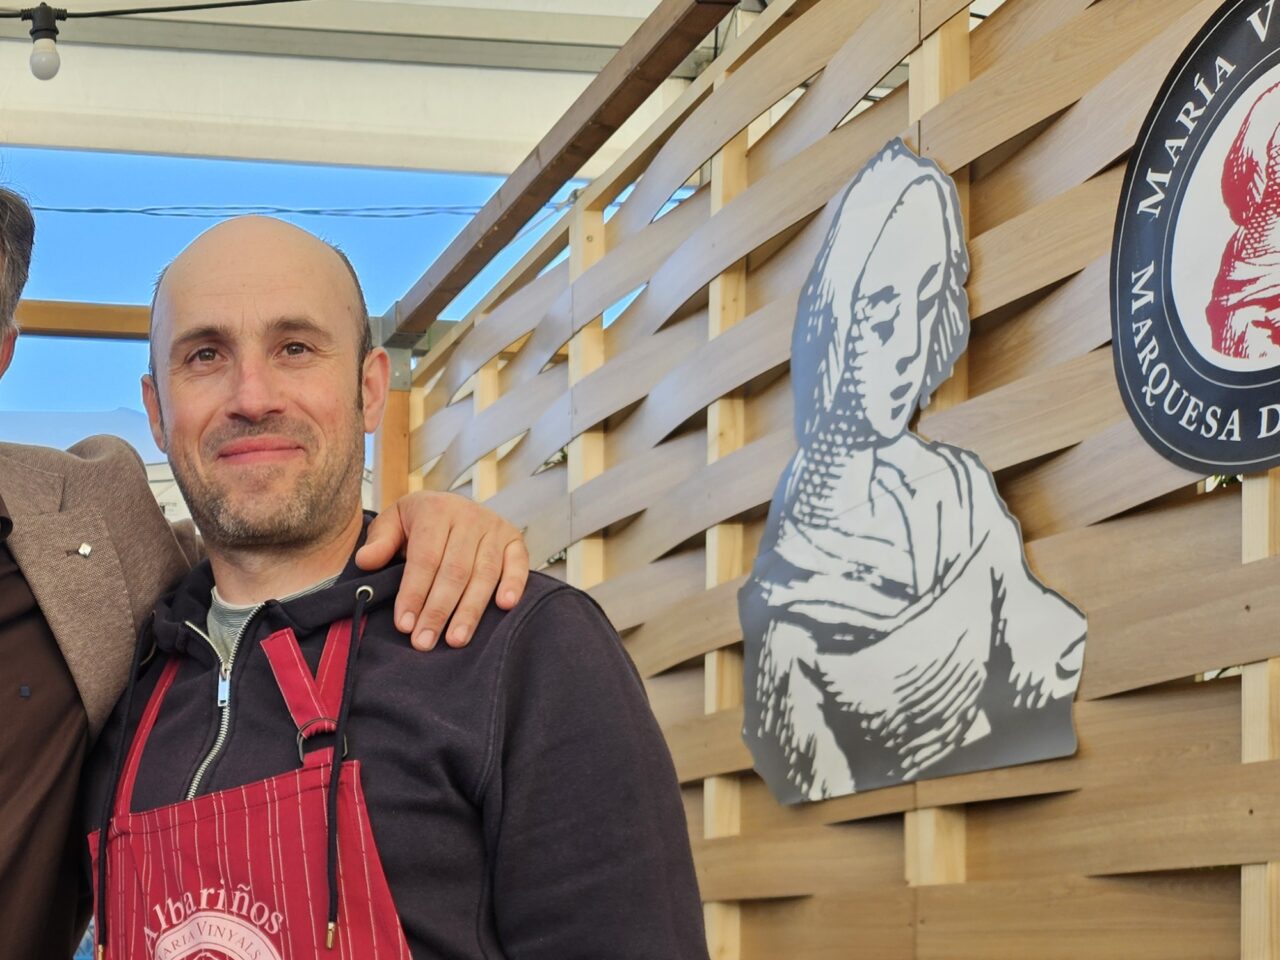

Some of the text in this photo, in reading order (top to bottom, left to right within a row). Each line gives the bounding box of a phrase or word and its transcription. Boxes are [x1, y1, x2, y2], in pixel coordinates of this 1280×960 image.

[1136, 55, 1236, 218] MARÍA
[1131, 260, 1280, 442] MARQUESA D
[143, 879, 284, 954] Albariños
[196, 920, 261, 960] VINYALS
